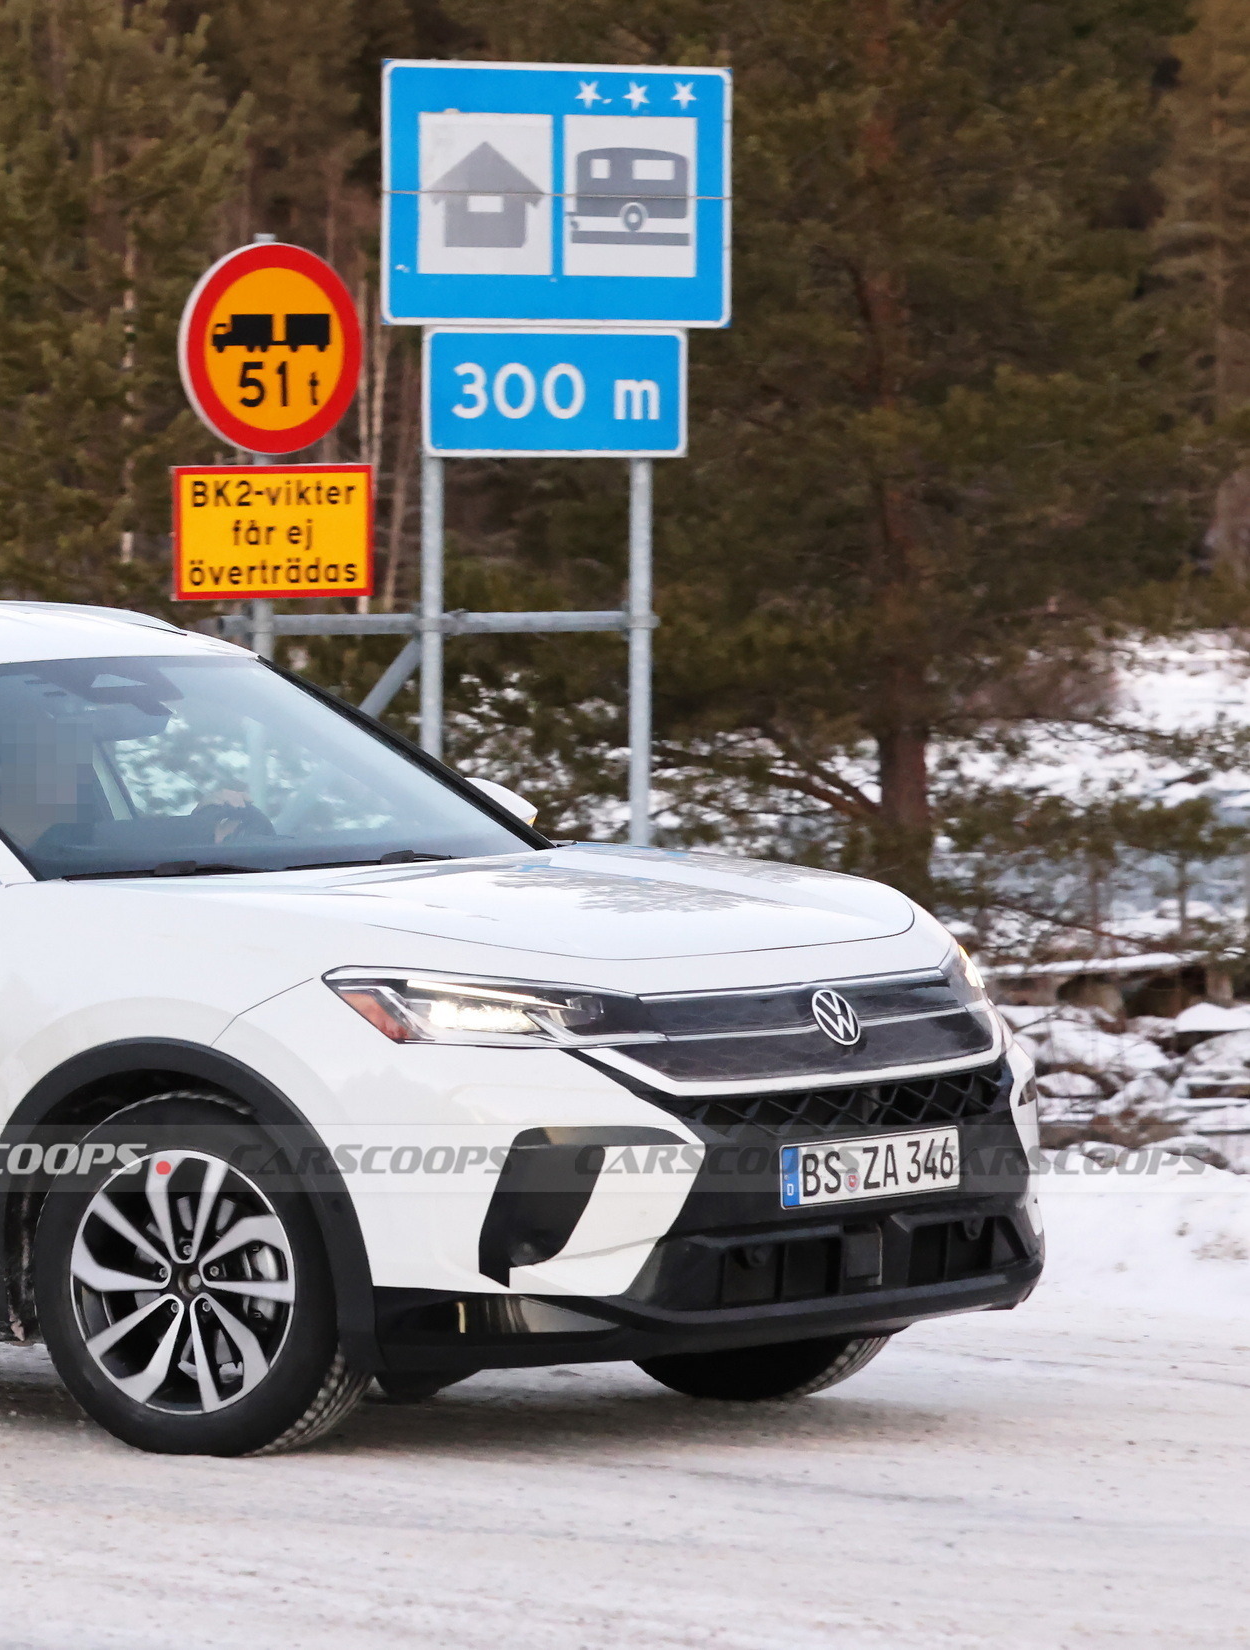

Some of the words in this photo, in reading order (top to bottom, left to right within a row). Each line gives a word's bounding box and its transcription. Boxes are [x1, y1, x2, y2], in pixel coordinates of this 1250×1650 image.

[238, 361, 290, 408] 51
[308, 372, 321, 406] t
[452, 362, 586, 419] 300
[614, 378, 661, 420] m
[191, 480, 356, 508] BK2-vikter
[232, 519, 276, 546] får
[287, 518, 314, 551] ej
[188, 557, 358, 586] överträdas
[801, 1150, 842, 1198] BS
[862, 1143, 899, 1190] ZA
[906, 1136, 954, 1184] 346
[786, 1183, 794, 1197] D
